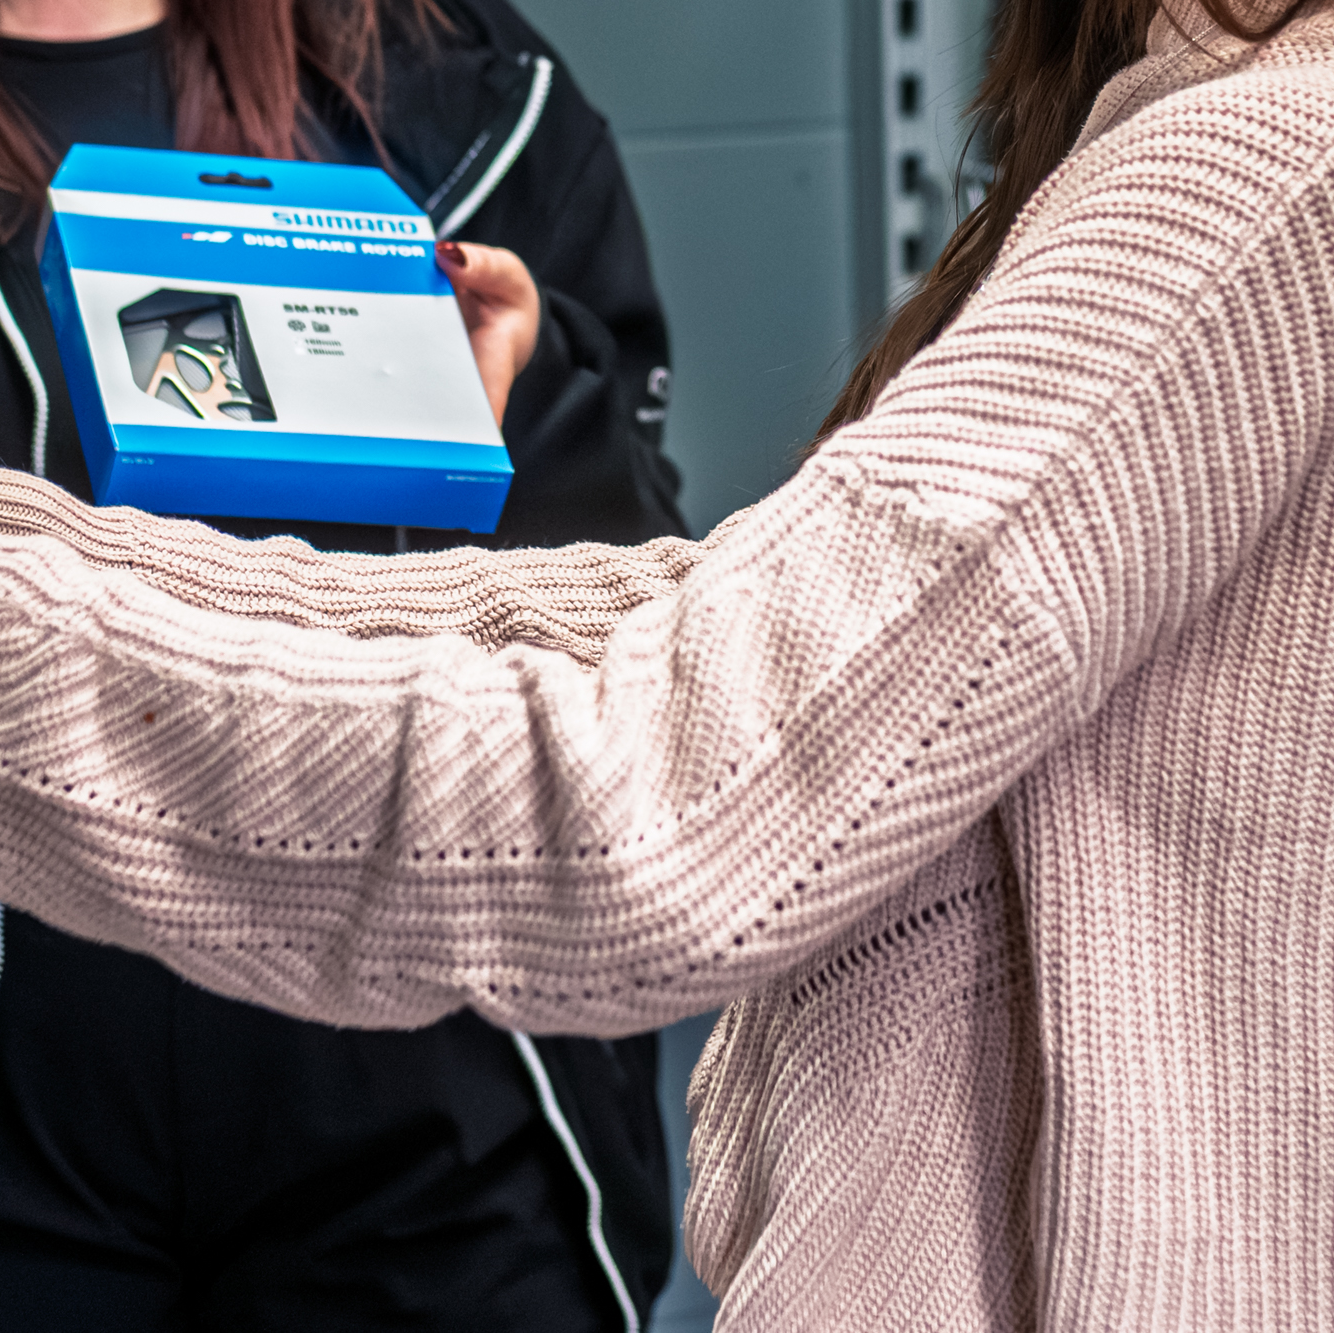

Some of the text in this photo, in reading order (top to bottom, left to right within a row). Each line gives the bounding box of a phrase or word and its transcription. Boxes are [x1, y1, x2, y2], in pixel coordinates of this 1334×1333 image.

[272, 212, 417, 235] SHIMANO
[243, 232, 426, 257] DISC BRAKE ROTOR
